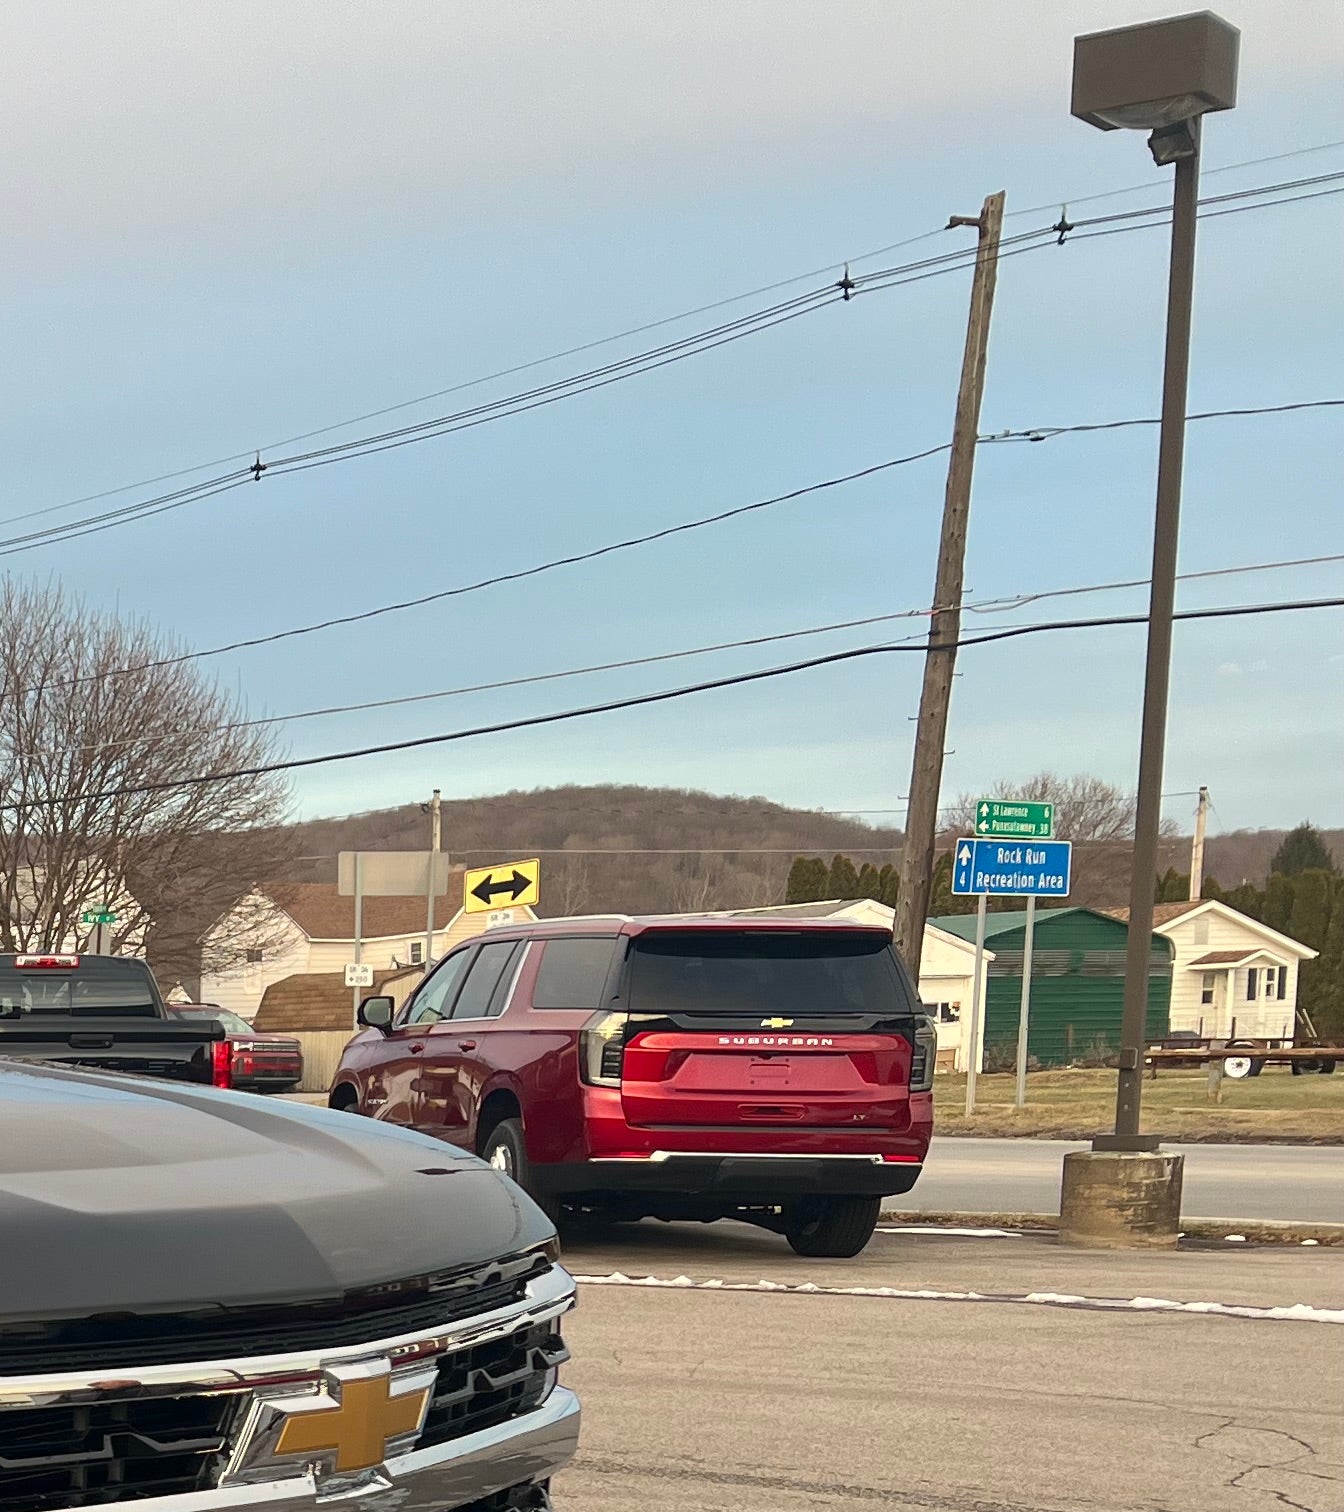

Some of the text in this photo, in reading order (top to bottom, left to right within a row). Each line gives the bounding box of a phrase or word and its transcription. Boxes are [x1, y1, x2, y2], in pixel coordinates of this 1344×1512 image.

[1044, 807, 1050, 818] 6
[997, 847, 1046, 865] Rock Run
[959, 871, 966, 887] 4
[976, 871, 1064, 889] Recreation Area
[718, 1037, 833, 1046] SUBURBAN
